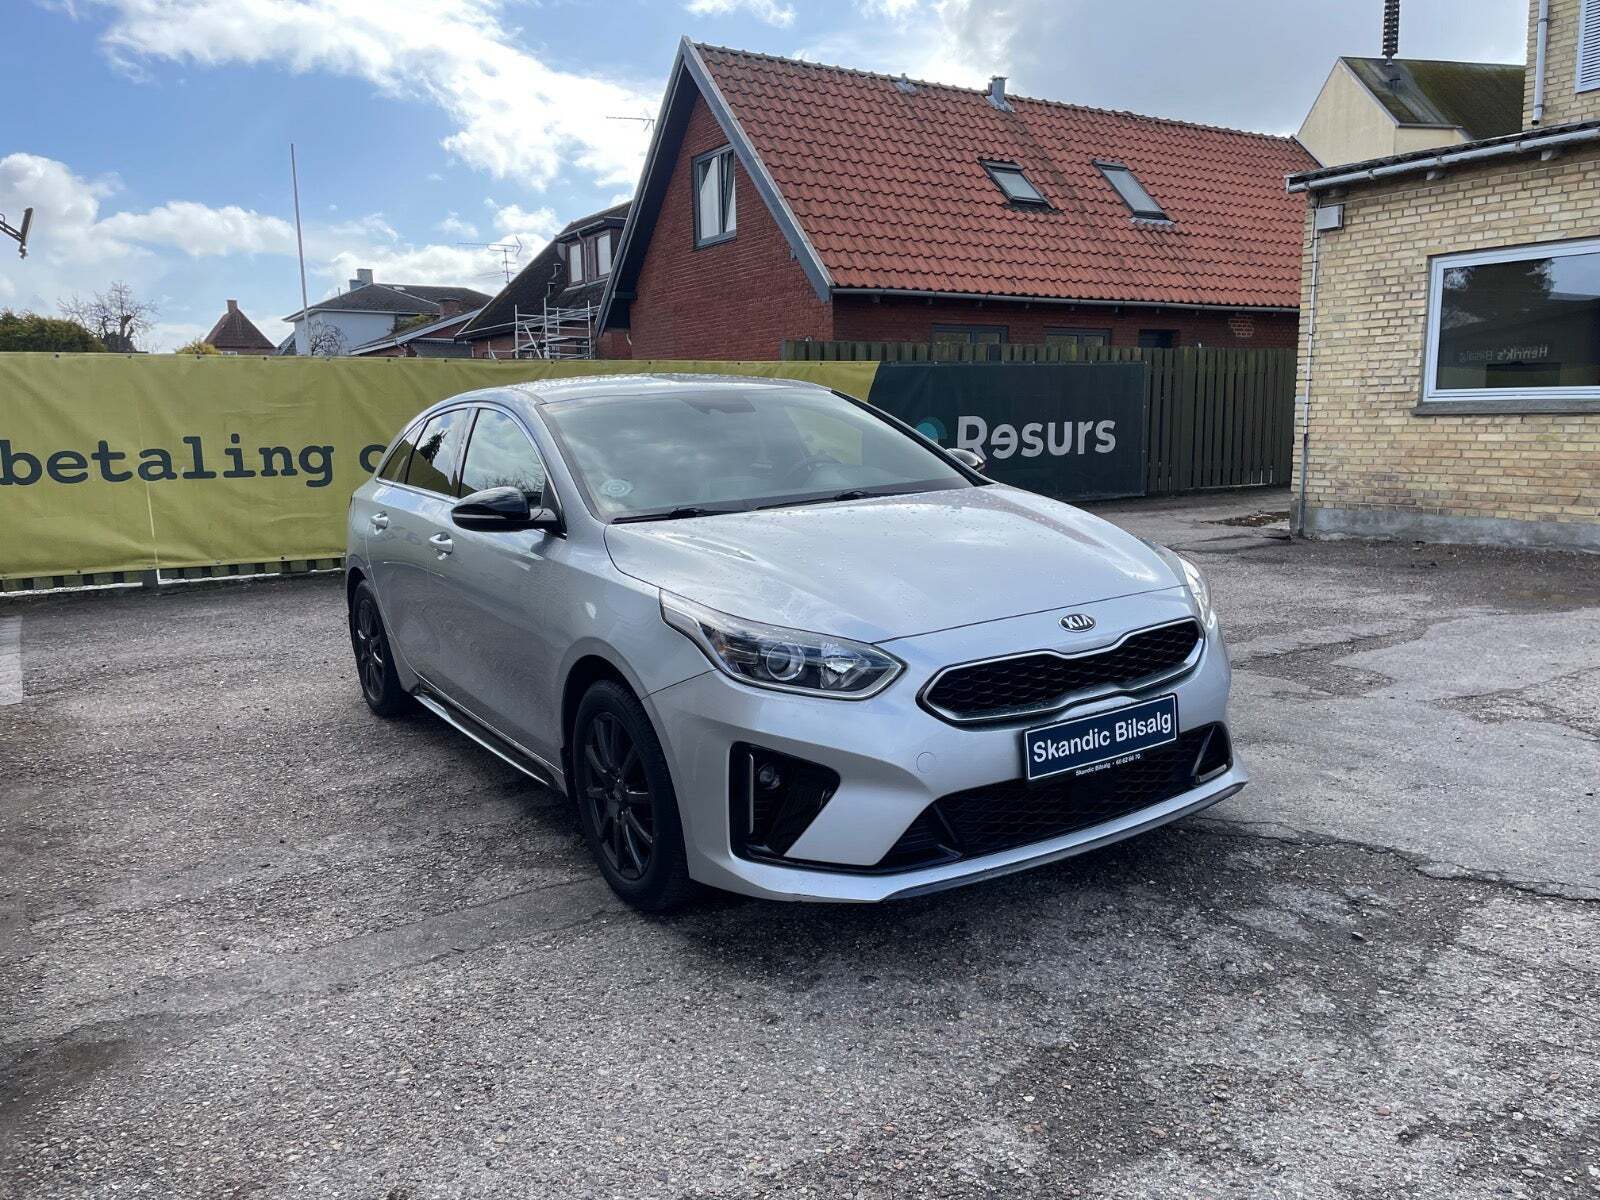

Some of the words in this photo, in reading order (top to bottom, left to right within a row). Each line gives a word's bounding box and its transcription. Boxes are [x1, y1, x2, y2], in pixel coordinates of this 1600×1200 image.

[0, 433, 335, 488] betaling
[957, 415, 1116, 460] Resurs
[1063, 614, 1093, 629] KIA
[1033, 728, 1110, 762] Skandic
[1115, 711, 1171, 742] Bilsalg
